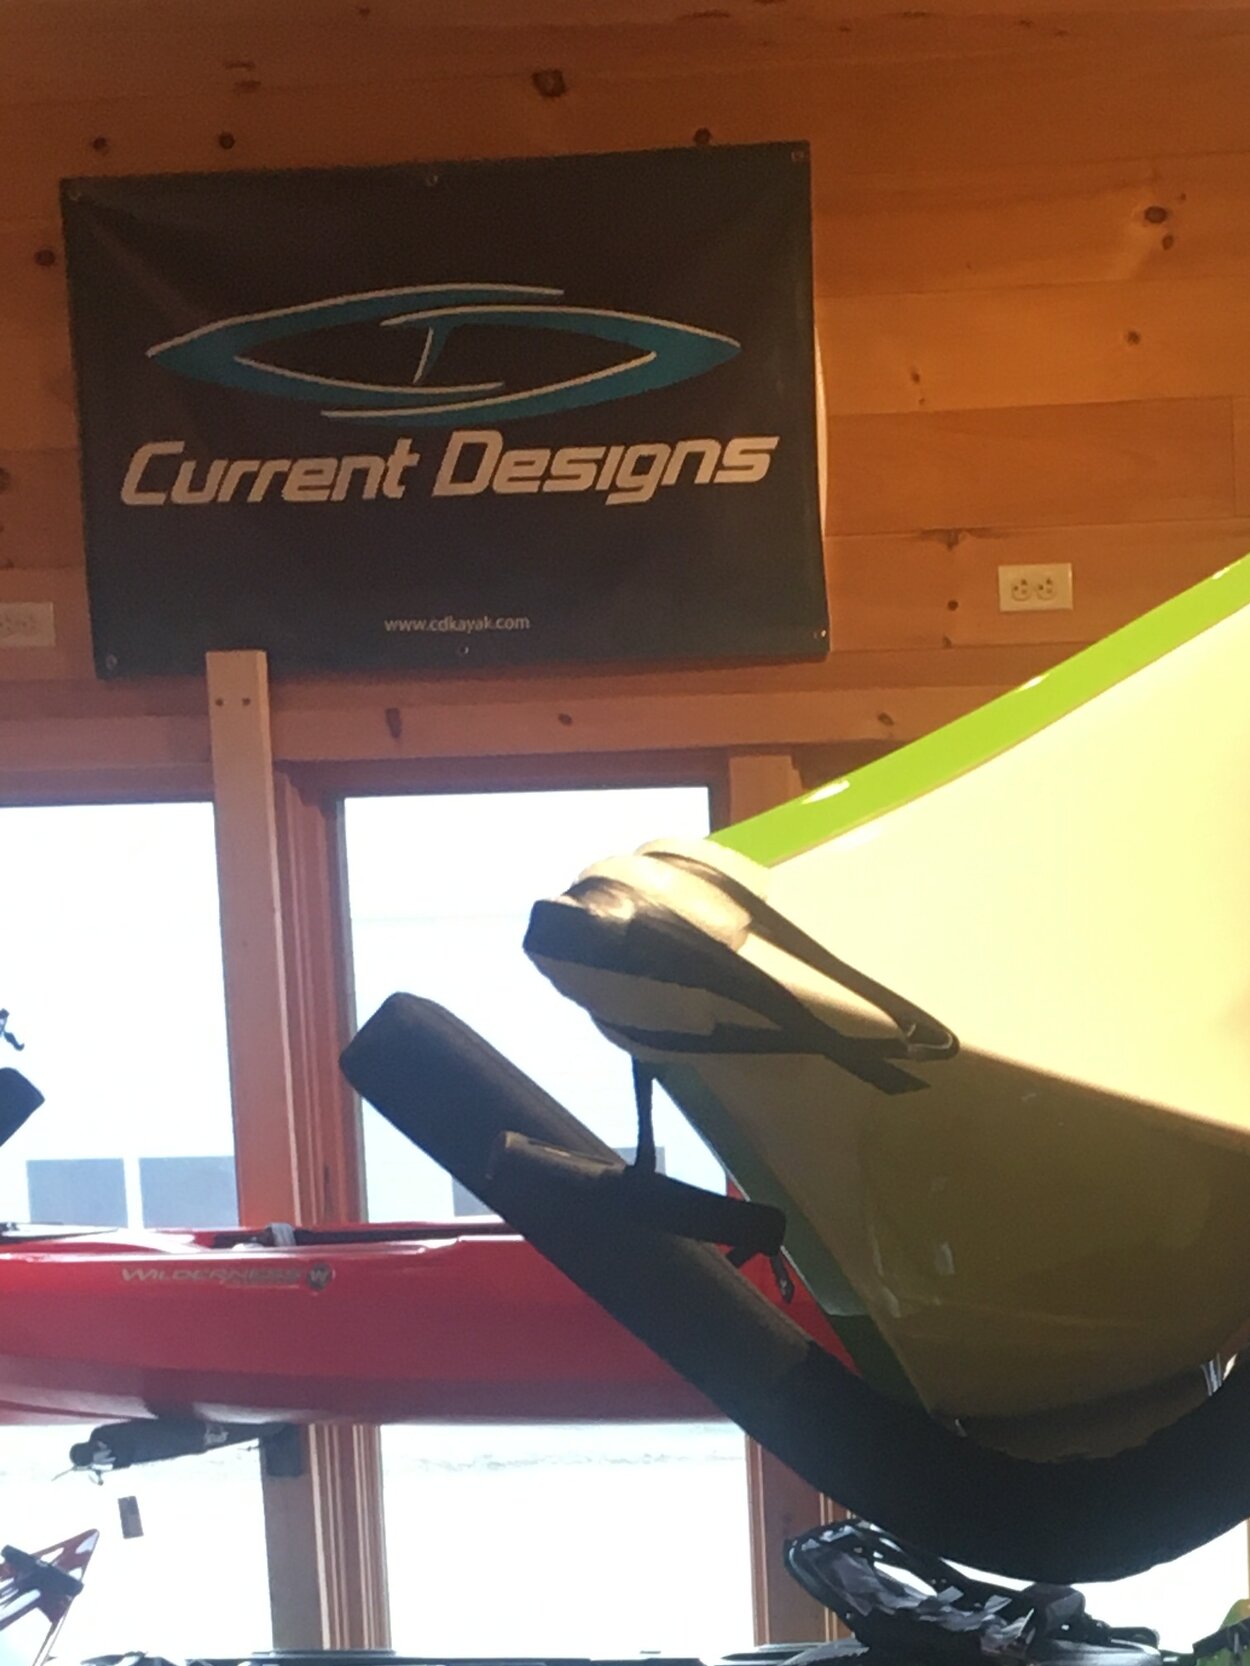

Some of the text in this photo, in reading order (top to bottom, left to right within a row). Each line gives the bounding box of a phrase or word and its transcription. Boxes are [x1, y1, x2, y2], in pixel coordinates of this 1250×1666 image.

[120, 430, 781, 505] Current Designs
[383, 615, 531, 633] www.cdkayak.com
[121, 1267, 300, 1282] WILDERNESS
